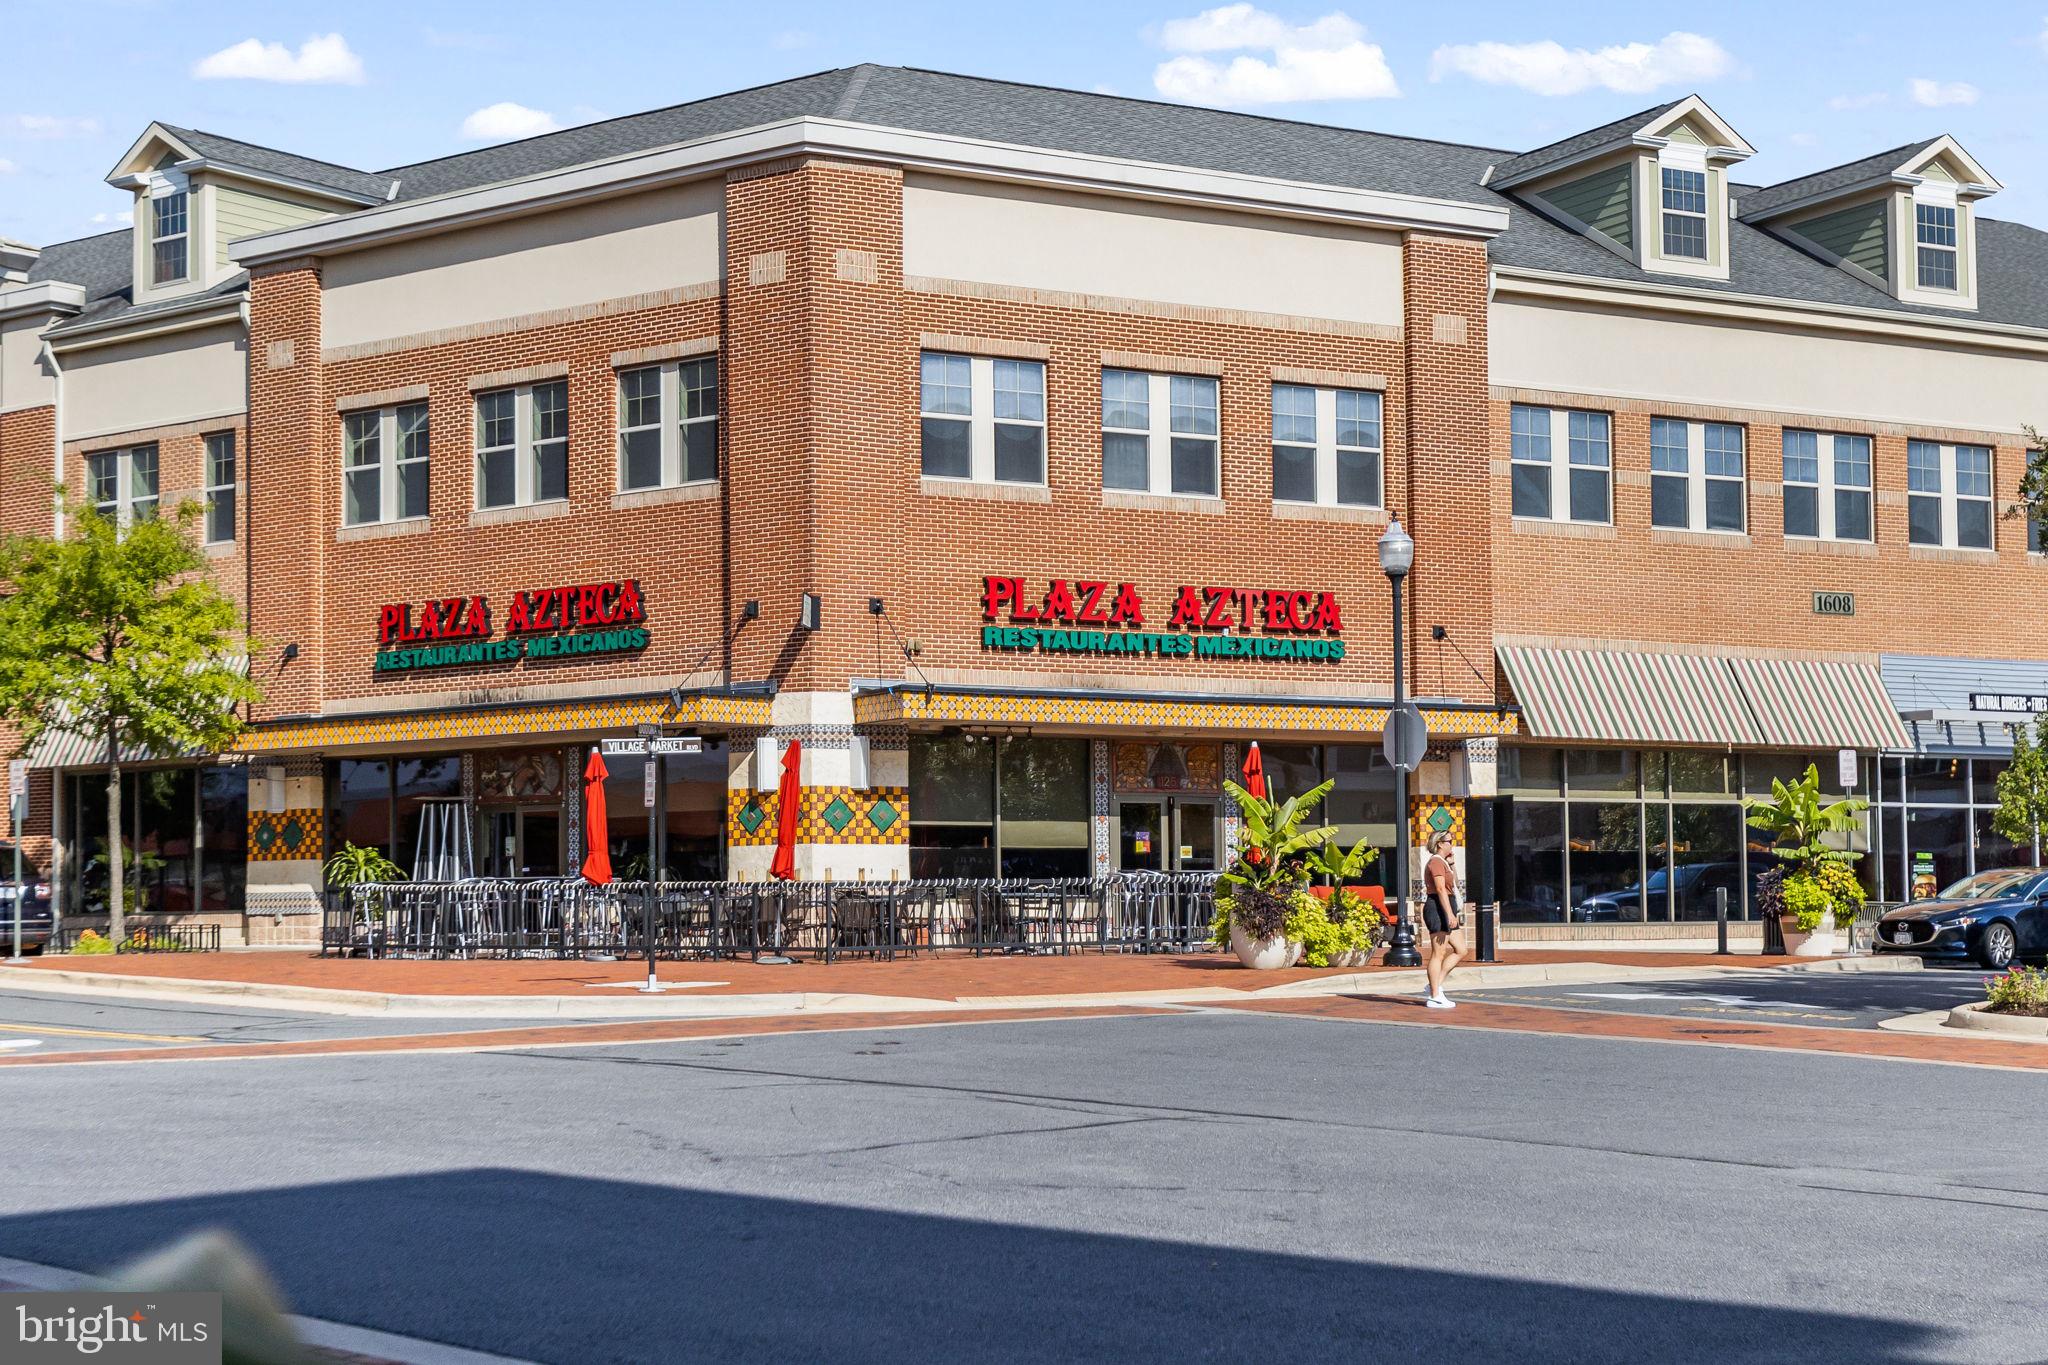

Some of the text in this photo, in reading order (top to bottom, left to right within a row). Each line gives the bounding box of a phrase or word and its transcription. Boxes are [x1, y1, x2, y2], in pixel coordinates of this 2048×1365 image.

[380, 579, 643, 642] PLAZA AZTECA
[984, 575, 1345, 631] PLAZA AZTECA
[1817, 595, 1851, 612] 1608
[376, 627, 649, 671] RESTAURANTES MEXICANOS
[983, 626, 1346, 659] RESTAURANTES MEXICANOS
[1975, 695, 2047, 712] NATURAL BURGERS FRIES
[608, 741, 645, 752] VILLAGE
[648, 740, 683, 751] MARKET
[1160, 776, 1178, 786] 125
